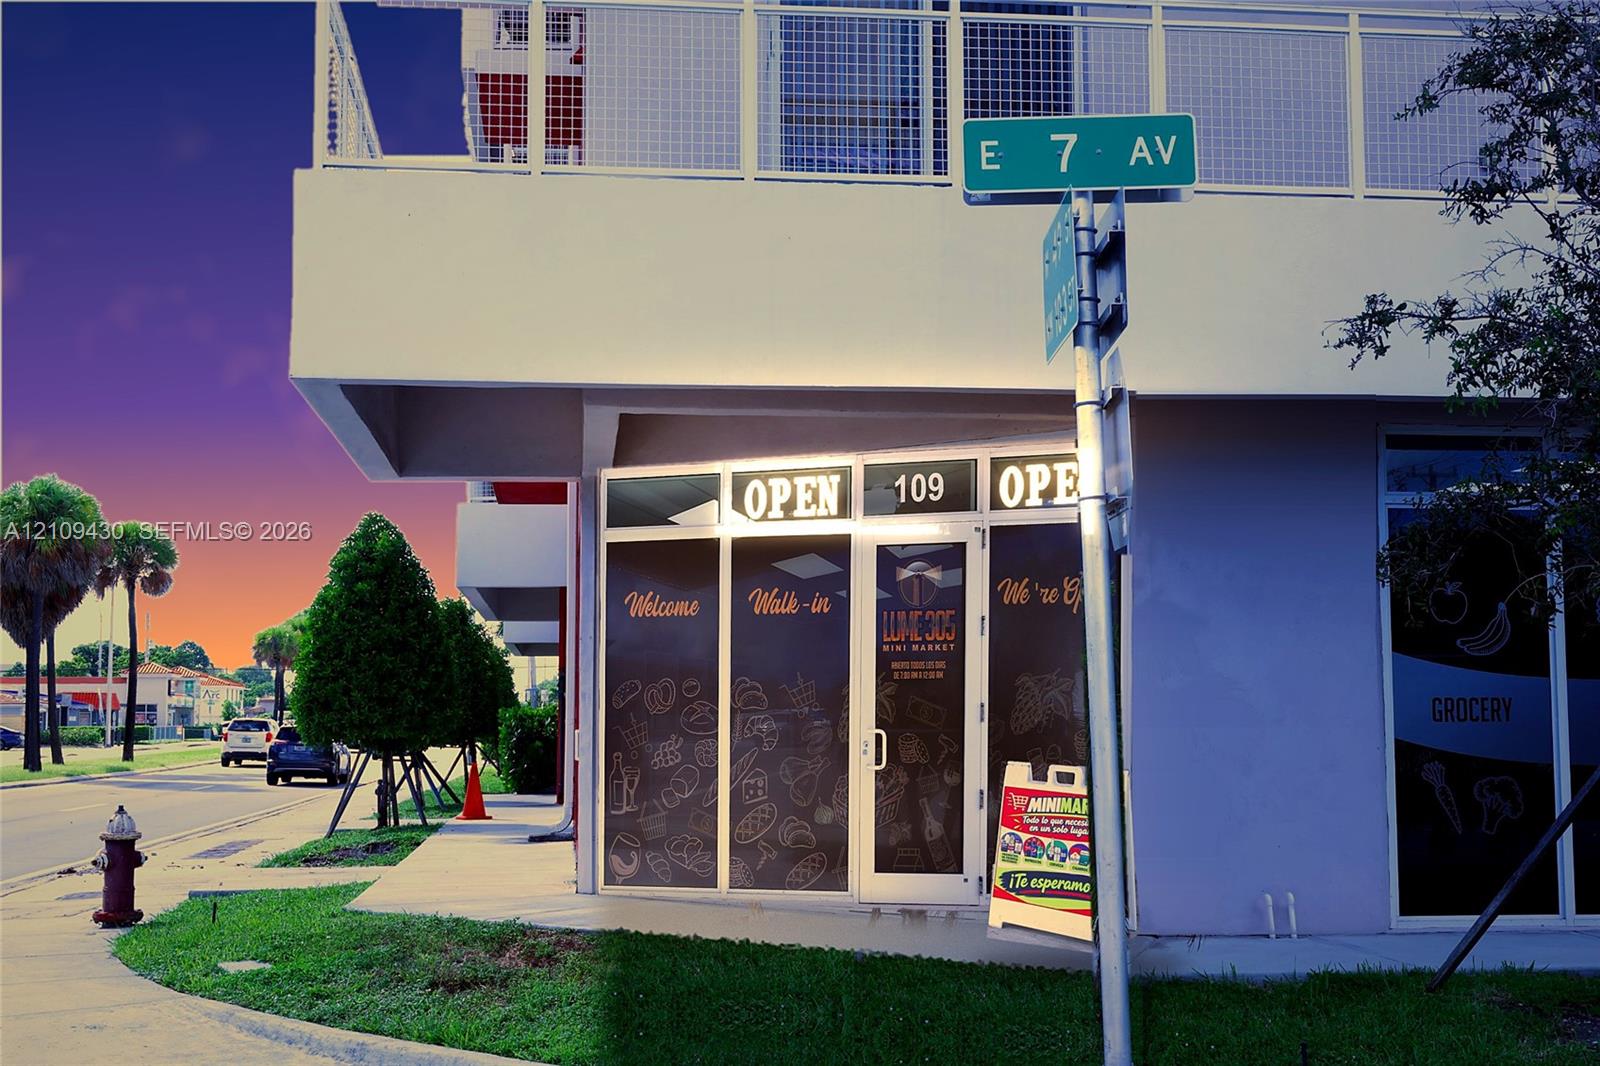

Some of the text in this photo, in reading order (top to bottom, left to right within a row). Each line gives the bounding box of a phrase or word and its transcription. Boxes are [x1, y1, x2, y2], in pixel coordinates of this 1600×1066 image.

[980, 133, 1177, 172] E 7 AV
[744, 474, 842, 520] OPEN
[894, 472, 945, 503] 109
[998, 461, 1079, 508] OPE
[624, 591, 699, 617] Welcome
[882, 643, 955, 652] MINI MARKET
[1432, 696, 1512, 723] GROCERY
[1027, 796, 1089, 814] MINIMAR
[1022, 815, 1089, 827] Todo lo que necesi
[1052, 825, 1069, 834] solo
[1070, 826, 1089, 837] luga
[1030, 877, 1091, 893] esperamo
